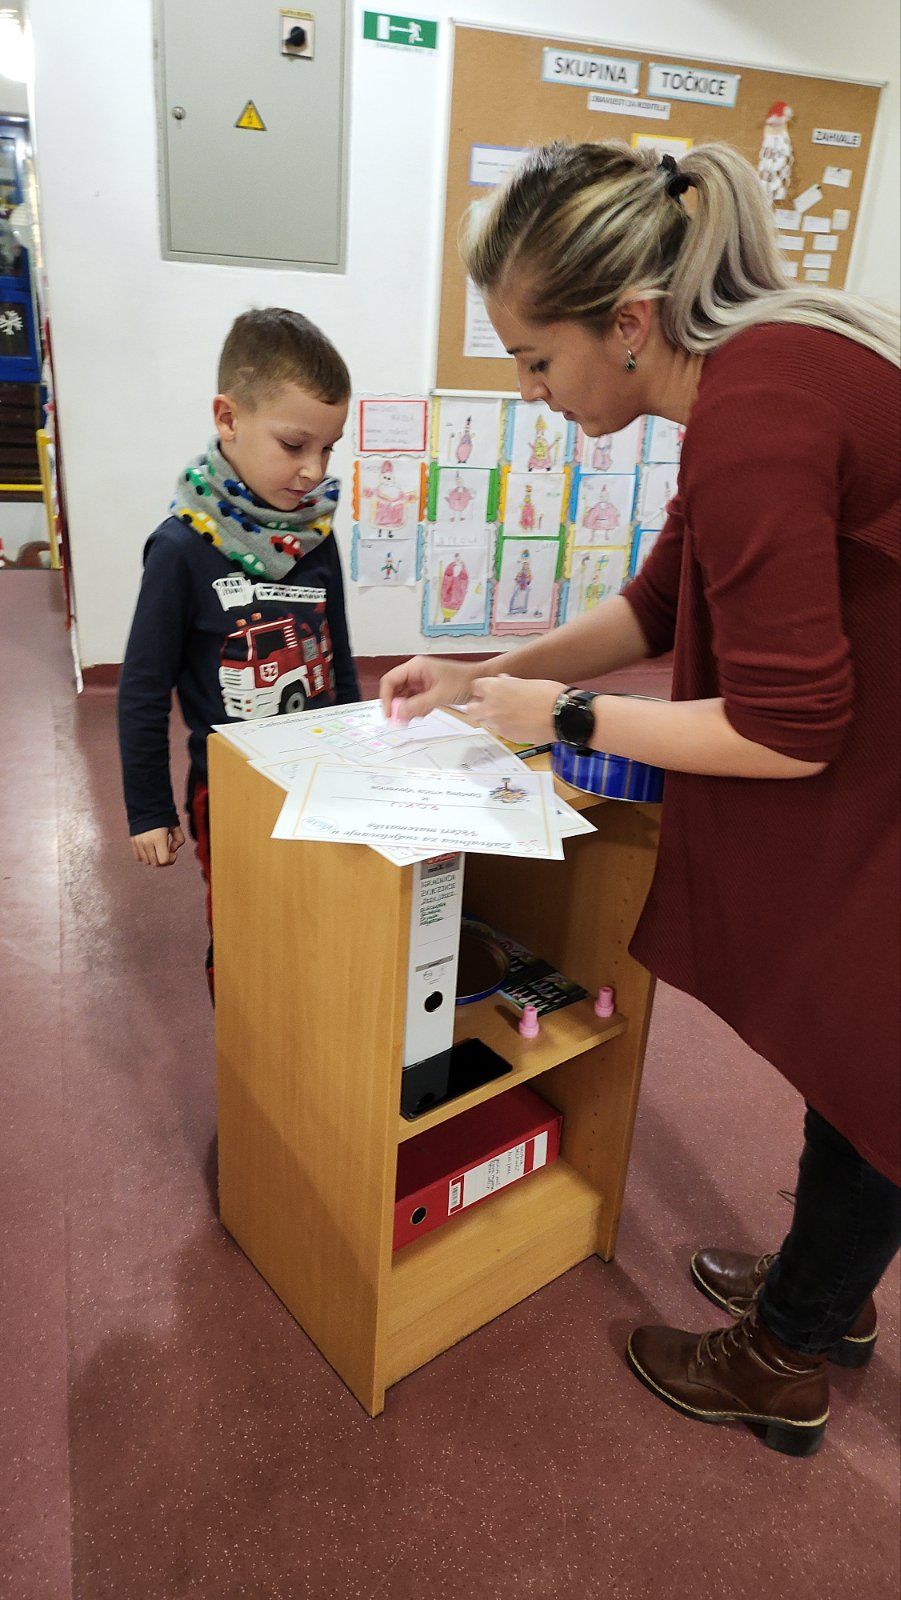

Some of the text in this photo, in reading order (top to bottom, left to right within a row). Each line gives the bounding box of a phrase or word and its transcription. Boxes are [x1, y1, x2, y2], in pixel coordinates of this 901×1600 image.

[554, 57, 727, 96] SKUPINA TOČKICE
[816, 131, 858, 145] ZAHVALE
[263, 664, 276, 677] 52
[366, 822, 437, 834] matematike
[342, 830, 418, 844] sudjelovanje
[421, 837, 438, 845] za
[439, 837, 512, 849] Zahvalnica
